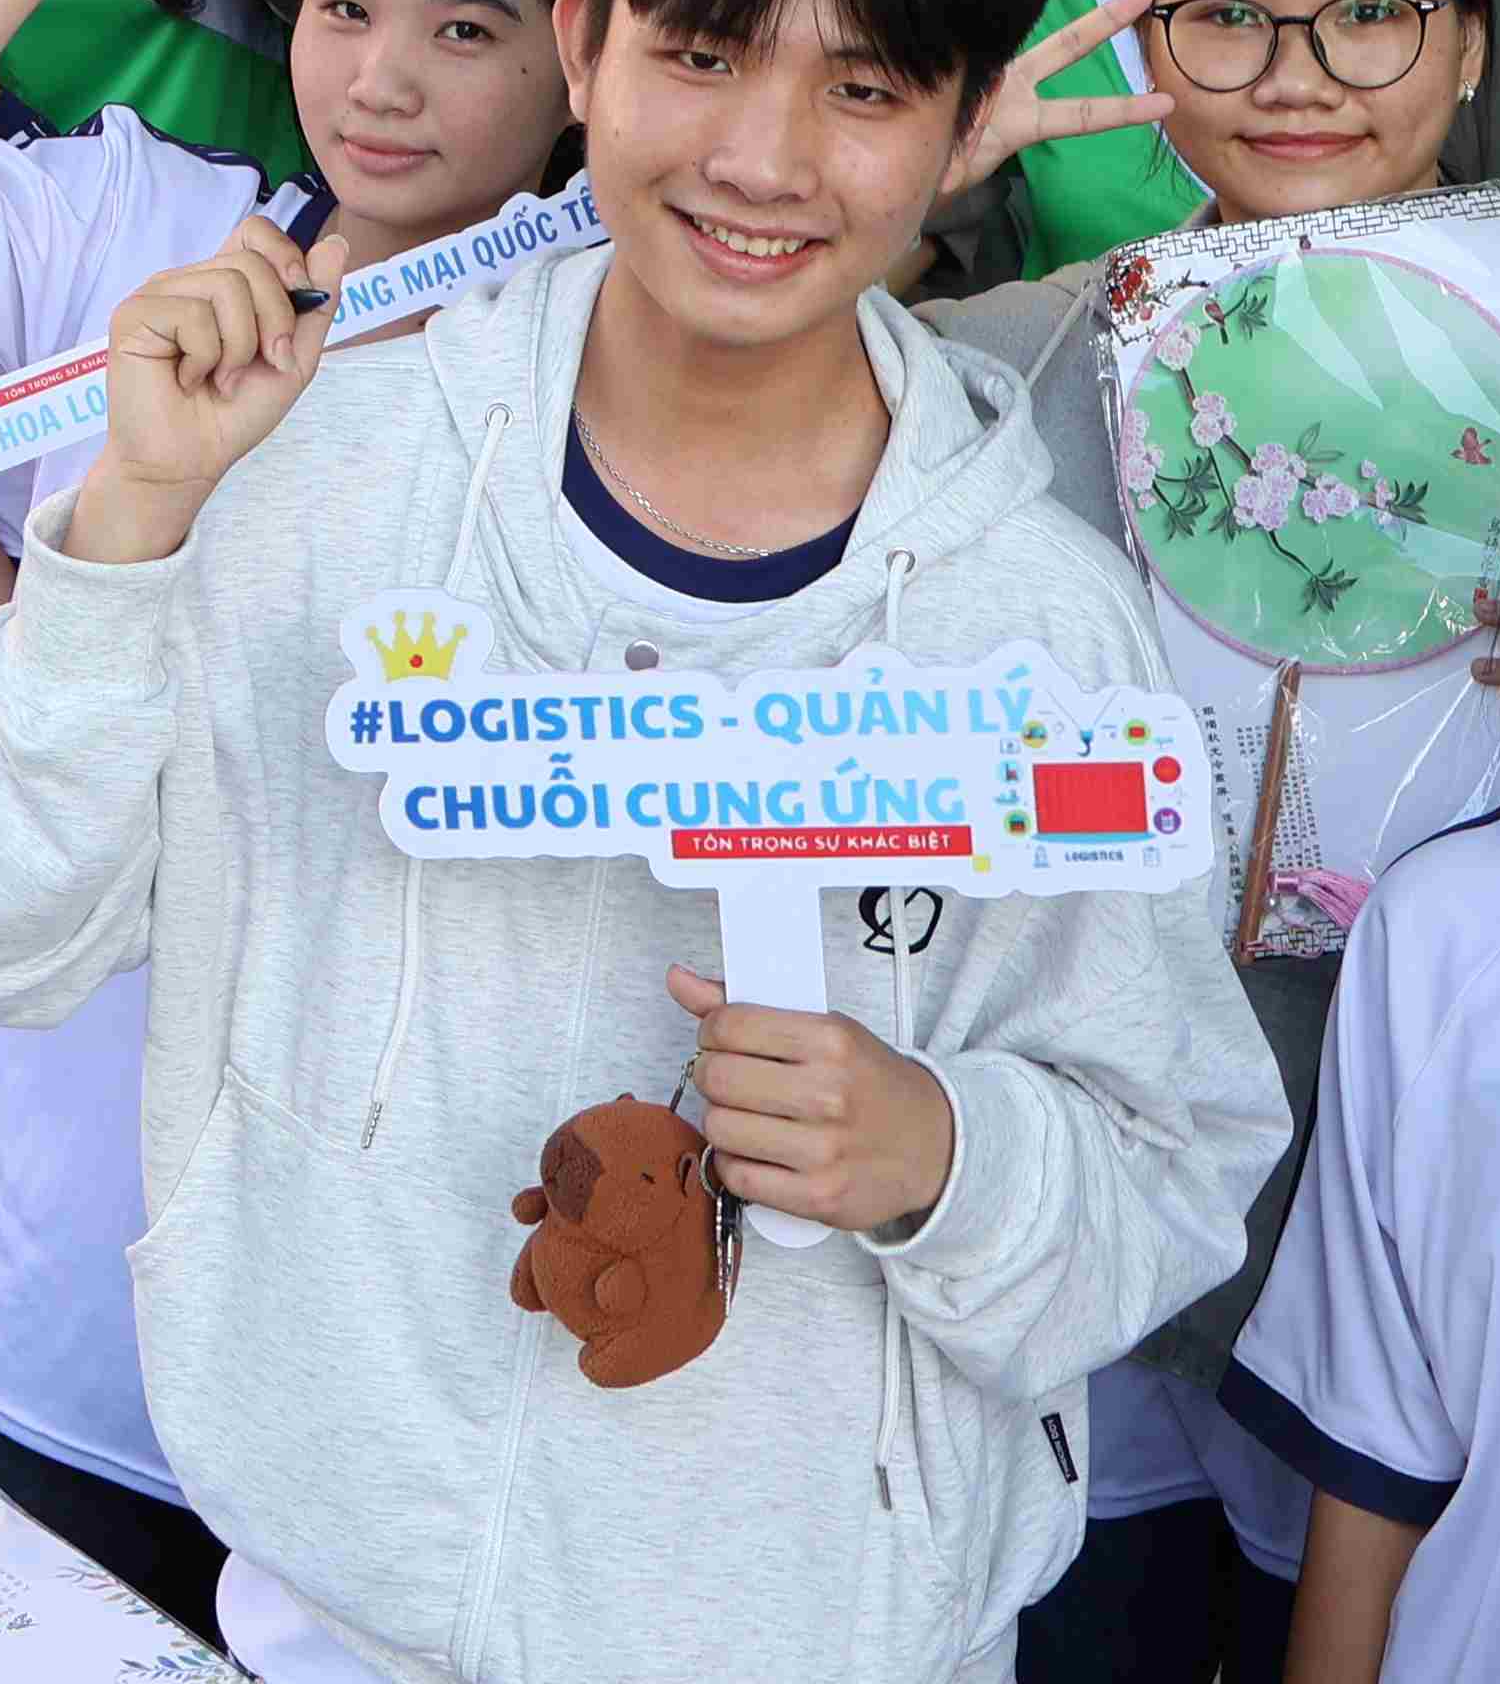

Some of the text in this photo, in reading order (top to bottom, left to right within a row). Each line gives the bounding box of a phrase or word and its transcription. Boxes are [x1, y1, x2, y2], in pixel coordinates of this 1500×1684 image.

[404, 244, 464, 294] MẠI
[472, 200, 559, 268] QUỐC
[3, 383, 28, 404] TÔN
[28, 372, 64, 397] TRỌNG
[65, 365, 80, 385] SỰ
[350, 691, 704, 747] #LOGISTICS
[754, 666, 952, 747] QUẢN
[967, 661, 1035, 737] LÝ
[403, 751, 968, 832] CHUỖI CUNG ỨNG
[691, 827, 953, 857] TÔN TRỌNG SỰ KHÁC BIỆT
[1064, 849, 1124, 863] LOGISTICS
